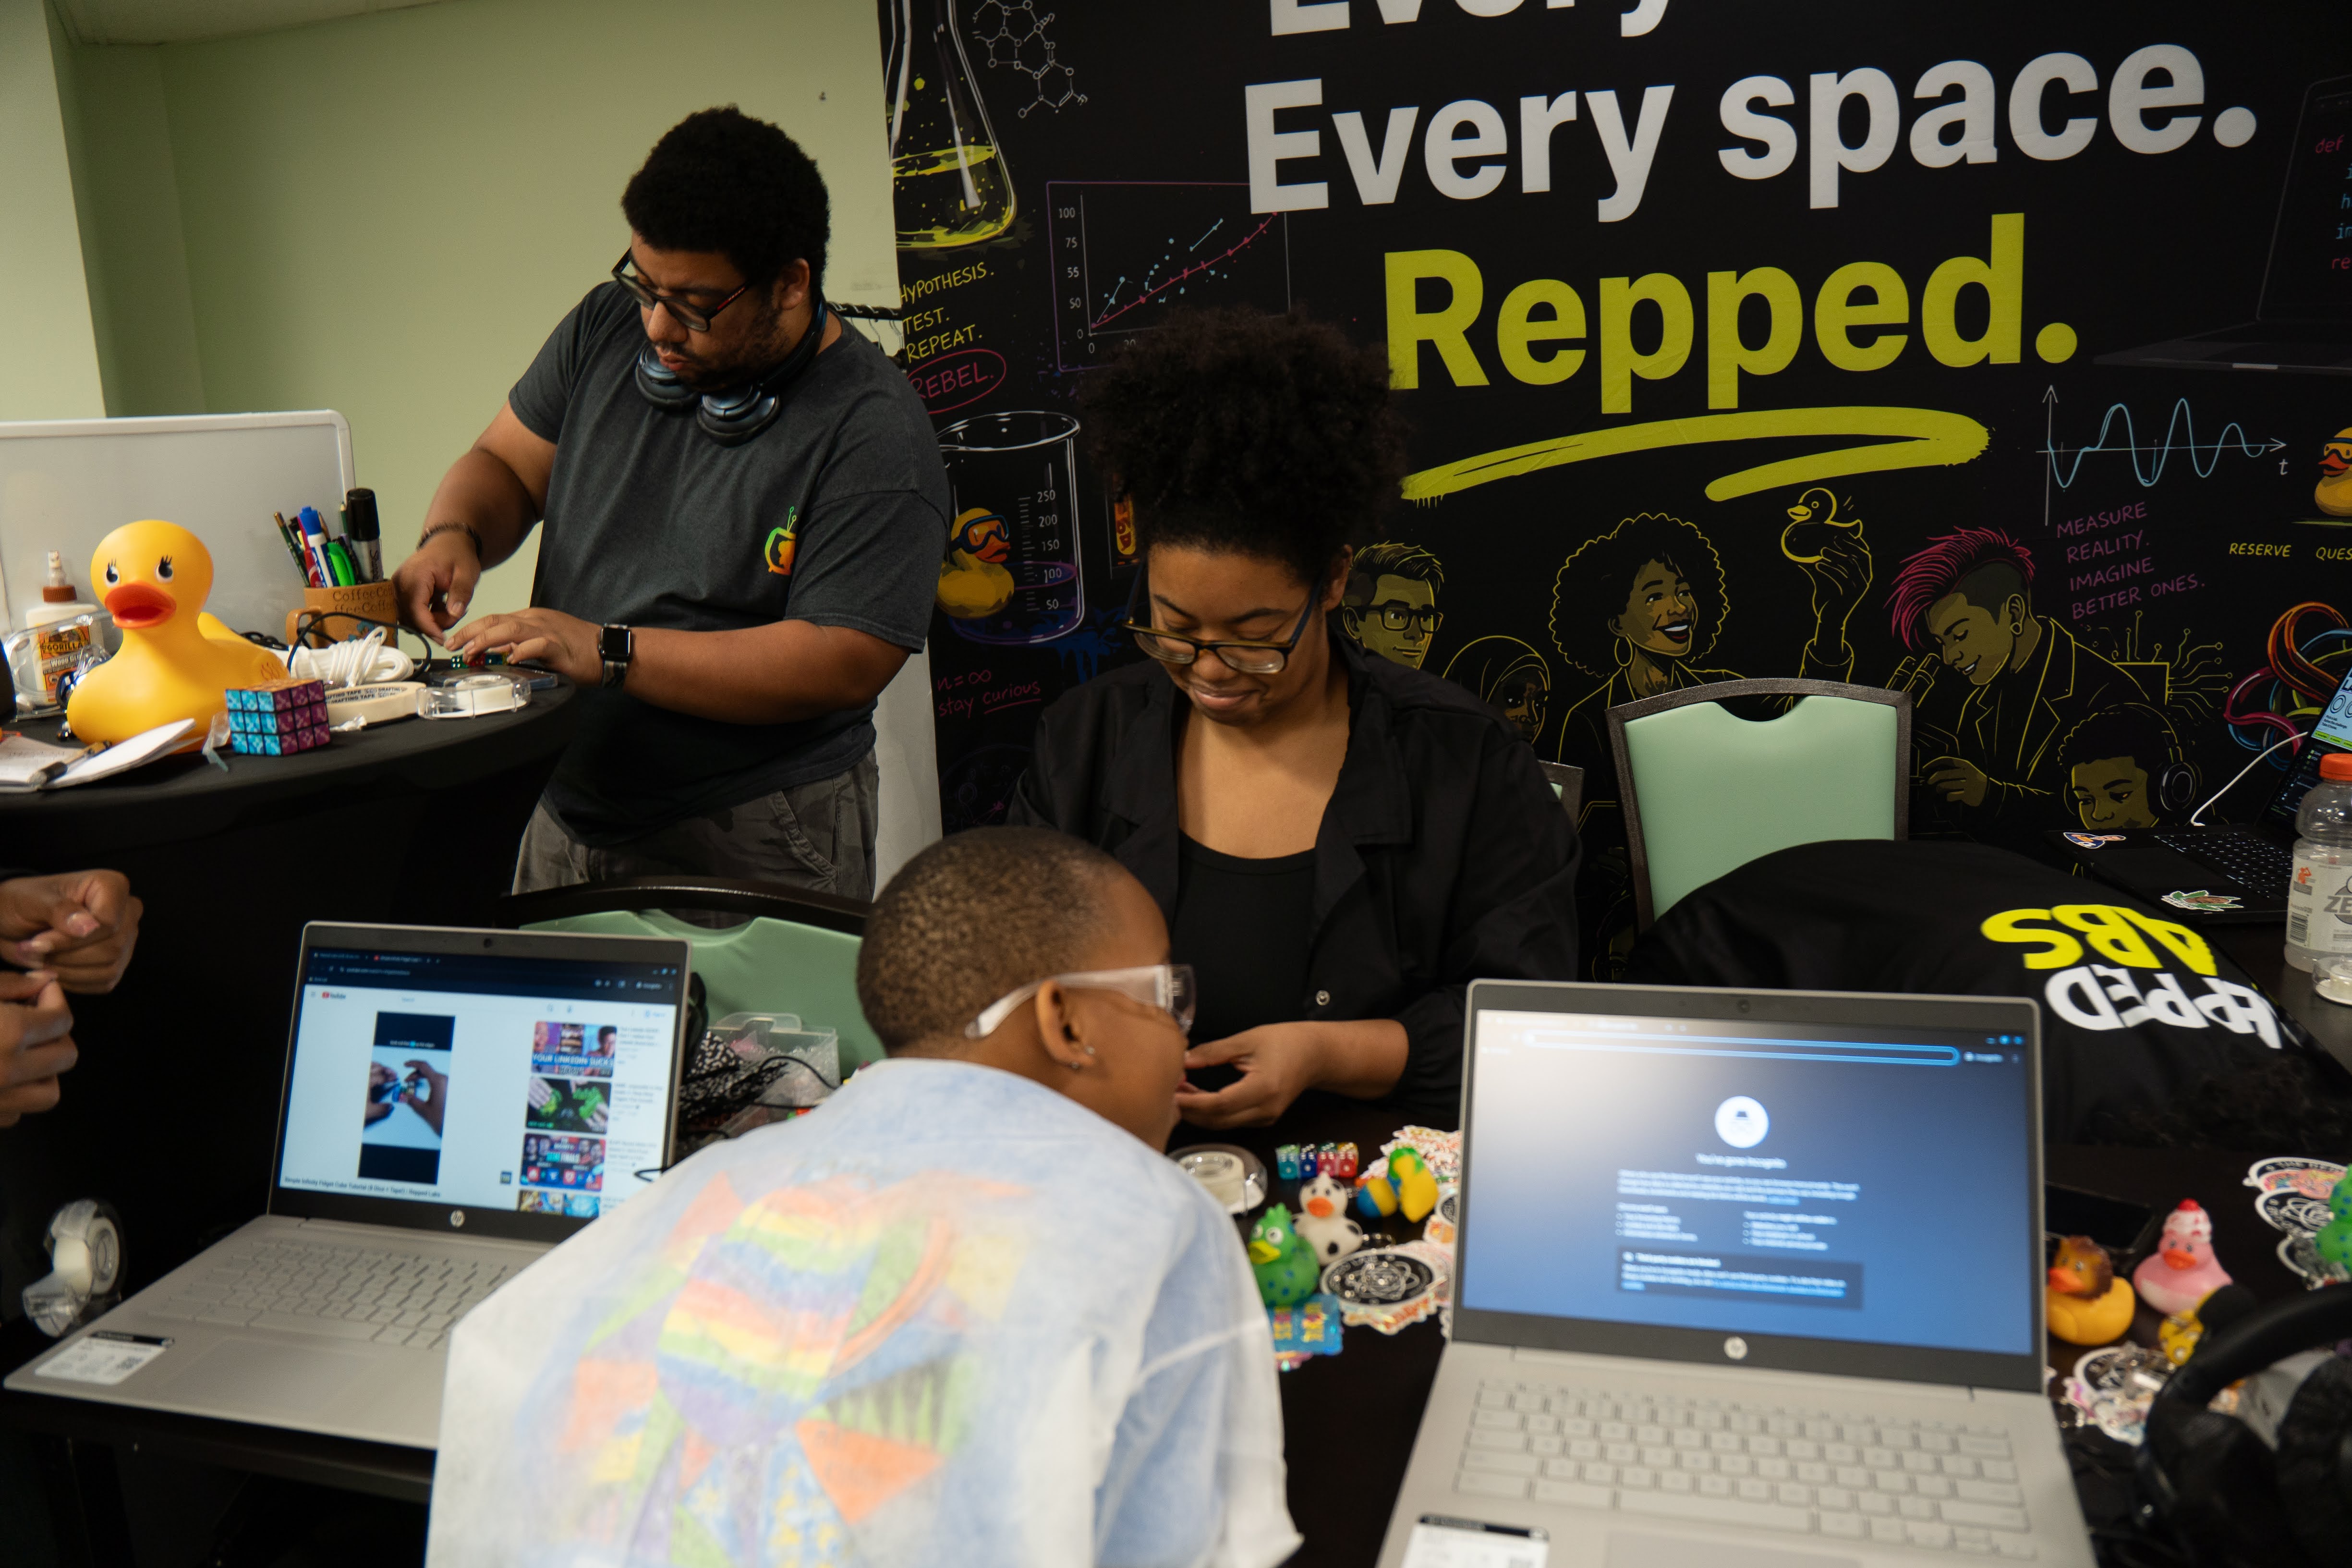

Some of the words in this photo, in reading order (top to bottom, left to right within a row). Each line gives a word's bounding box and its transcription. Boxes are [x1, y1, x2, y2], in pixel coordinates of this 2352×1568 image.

[1245, 78, 1675, 222] Every
[1718, 43, 2257, 209] space.
[2315, 134, 2345, 154] def
[1058, 207, 1076, 219] 100
[1065, 237, 1078, 248] 75
[900, 262, 994, 305] HYPOTHESIS.
[1067, 266, 1079, 278] 55
[1069, 297, 1081, 309] 50
[1384, 212, 2078, 413] Repped.
[903, 307, 950, 335] TEST.
[906, 324, 982, 364] REPEAT.
[910, 362, 994, 399] REBEL.
[2279, 459, 2289, 475] t
[1037, 489, 1056, 503] 250
[1039, 514, 1057, 528] 200
[2057, 501, 2147, 538] MEASURE
[1042, 539, 1060, 552] 150
[2066, 529, 2150, 564] REALITY.
[2229, 543, 2291, 557] RESERVE
[2316, 546, 2352, 561] QUES
[1044, 567, 1062, 583] 100
[2070, 557, 2155, 592] IMAGINE
[1046, 598, 1059, 610] 50
[2072, 587, 2142, 620] BETTER
[2150, 573, 2206, 597] ONES.
[939, 697, 974, 718] stay
[983, 681, 1041, 705] curious
[2324, 895, 2352, 913] ZE
[1981, 904, 2217, 976] ABS
[2045, 964, 2300, 1049] EPPED
